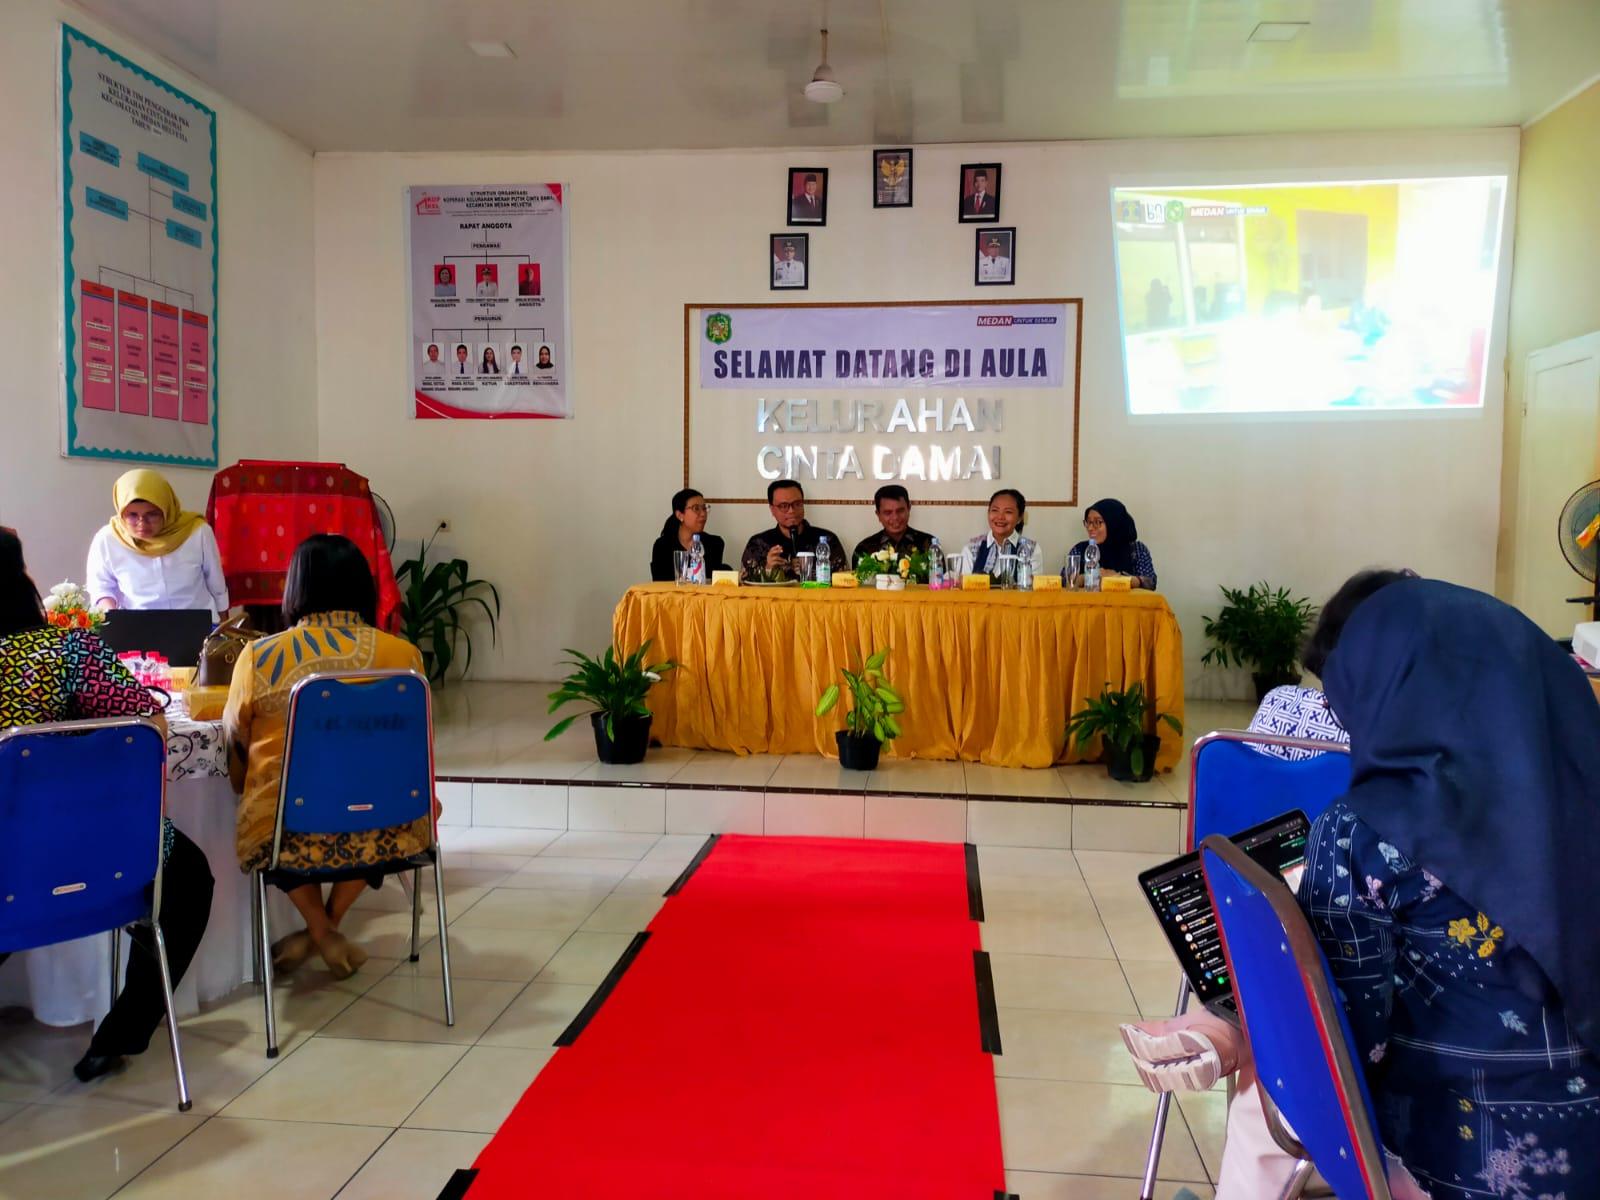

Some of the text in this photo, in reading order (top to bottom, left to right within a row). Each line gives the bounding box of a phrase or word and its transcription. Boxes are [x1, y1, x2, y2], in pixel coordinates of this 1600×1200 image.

[1190, 207, 1225, 217] MEDAN
[978, 317, 1012, 326] MEDAN
[713, 347, 1048, 379] SELAMAT DATANG DI AULA
[757, 397, 1003, 433] KELURAHAN
[756, 444, 1001, 481] CINTA DAMAI
